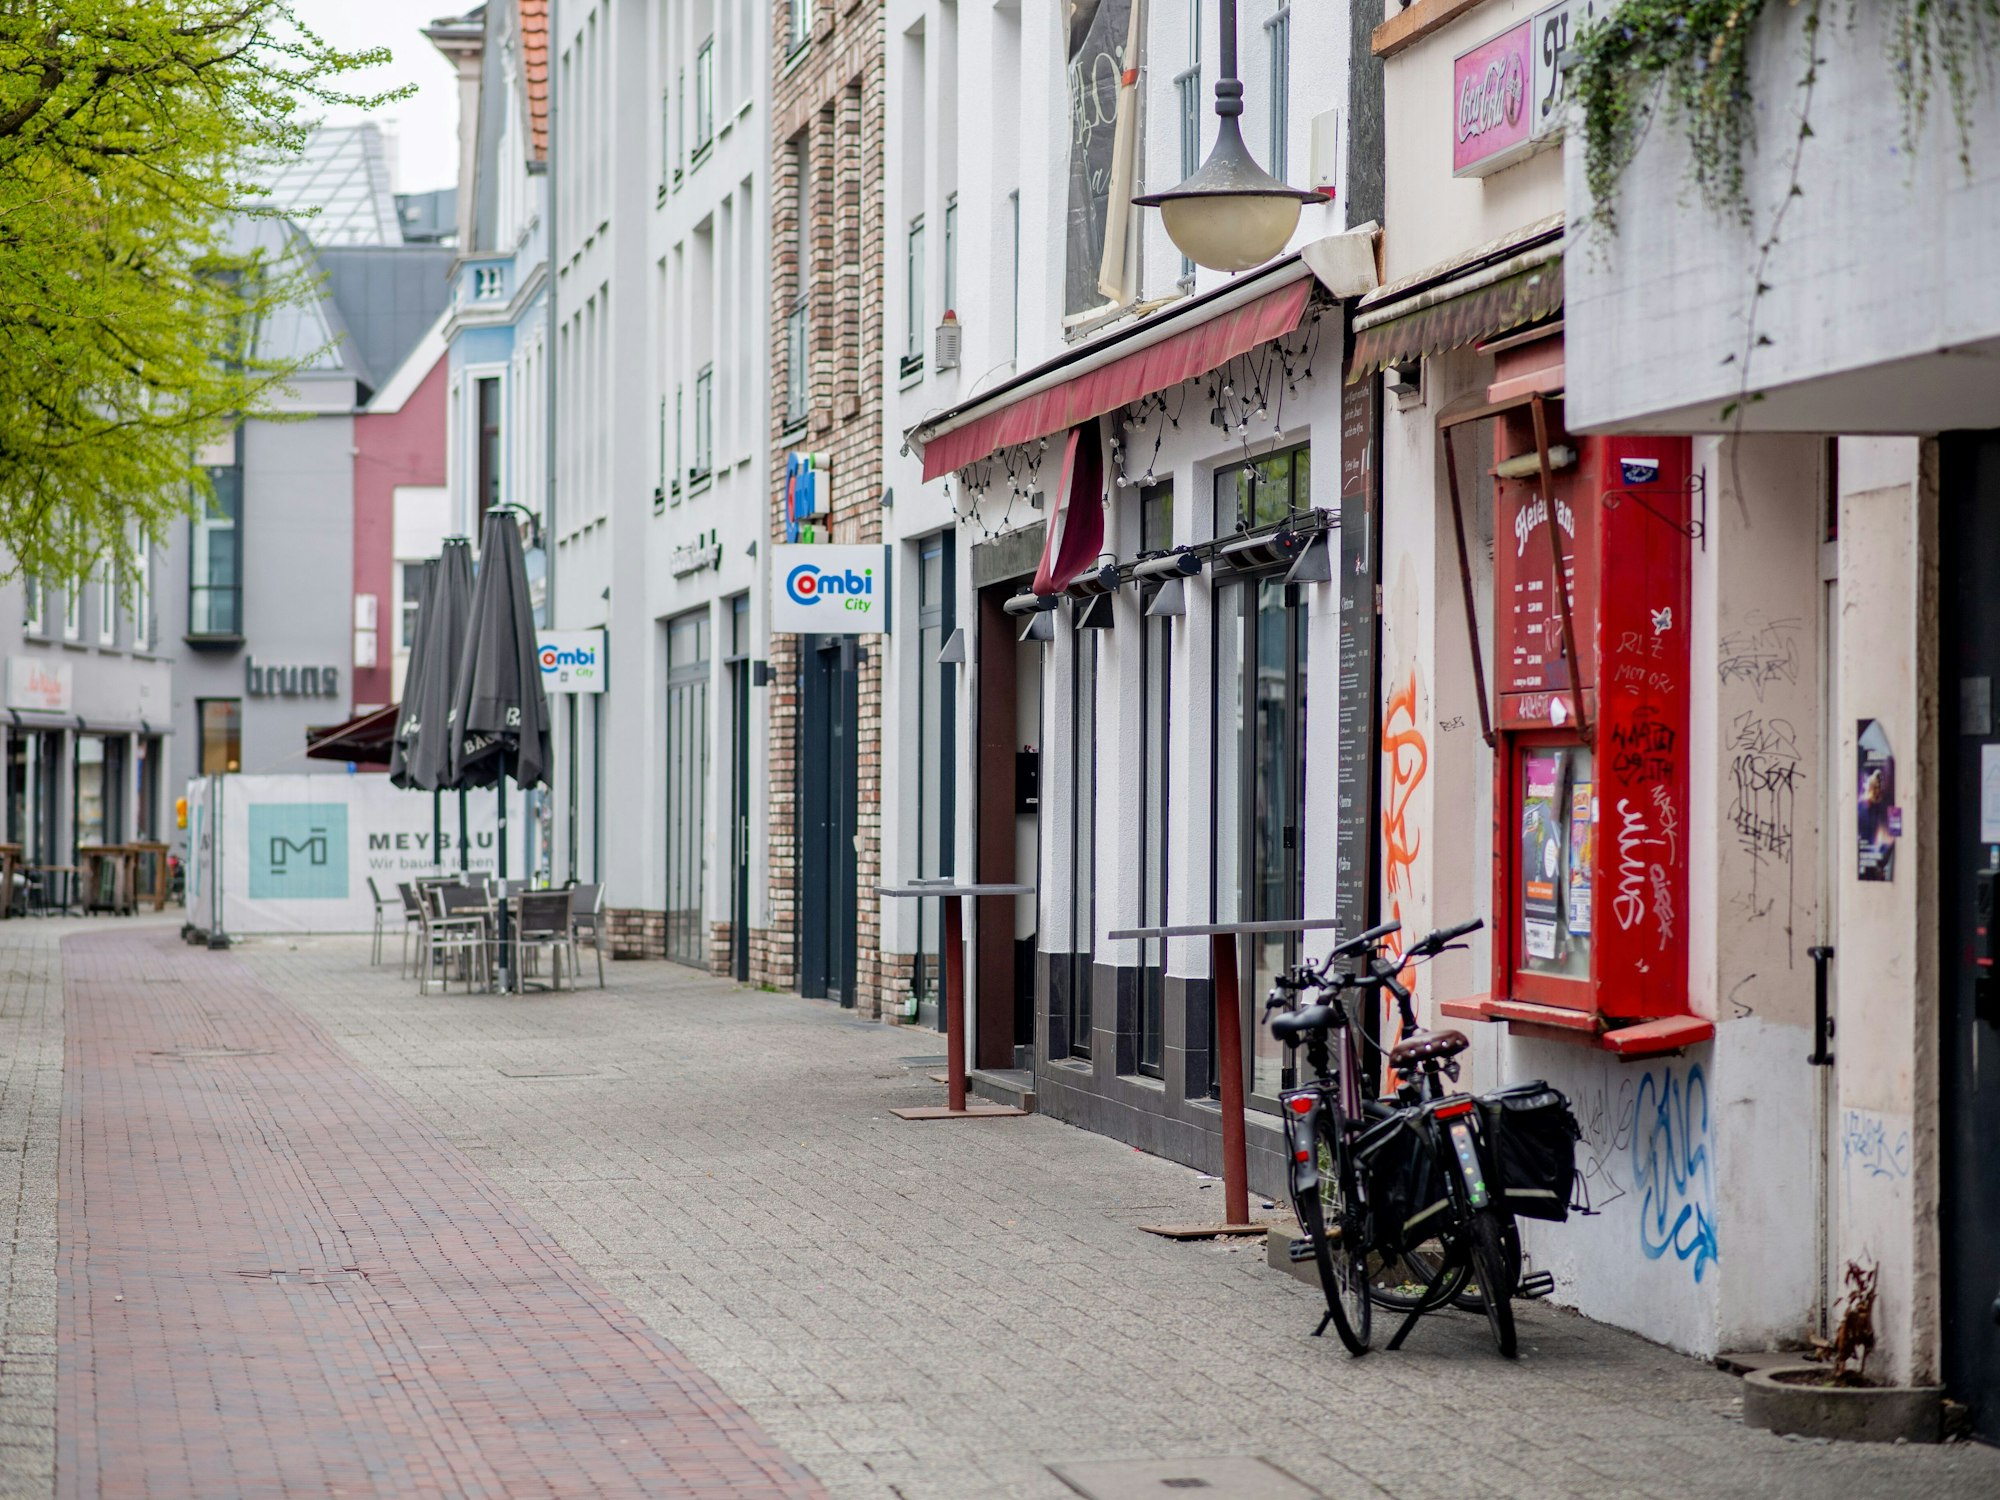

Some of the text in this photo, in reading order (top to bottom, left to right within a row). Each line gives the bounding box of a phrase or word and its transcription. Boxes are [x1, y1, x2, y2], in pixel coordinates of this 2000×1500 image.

[1515, 493, 1575, 558] Heieran
[786, 564, 872, 606] Combi
[845, 598, 872, 613] City
[537, 644, 596, 673] Combi
[246, 655, 338, 697] bruns
[575, 667, 594, 679] City
[369, 857, 393, 869] Wir
[452, 856, 494, 868] Ieen
